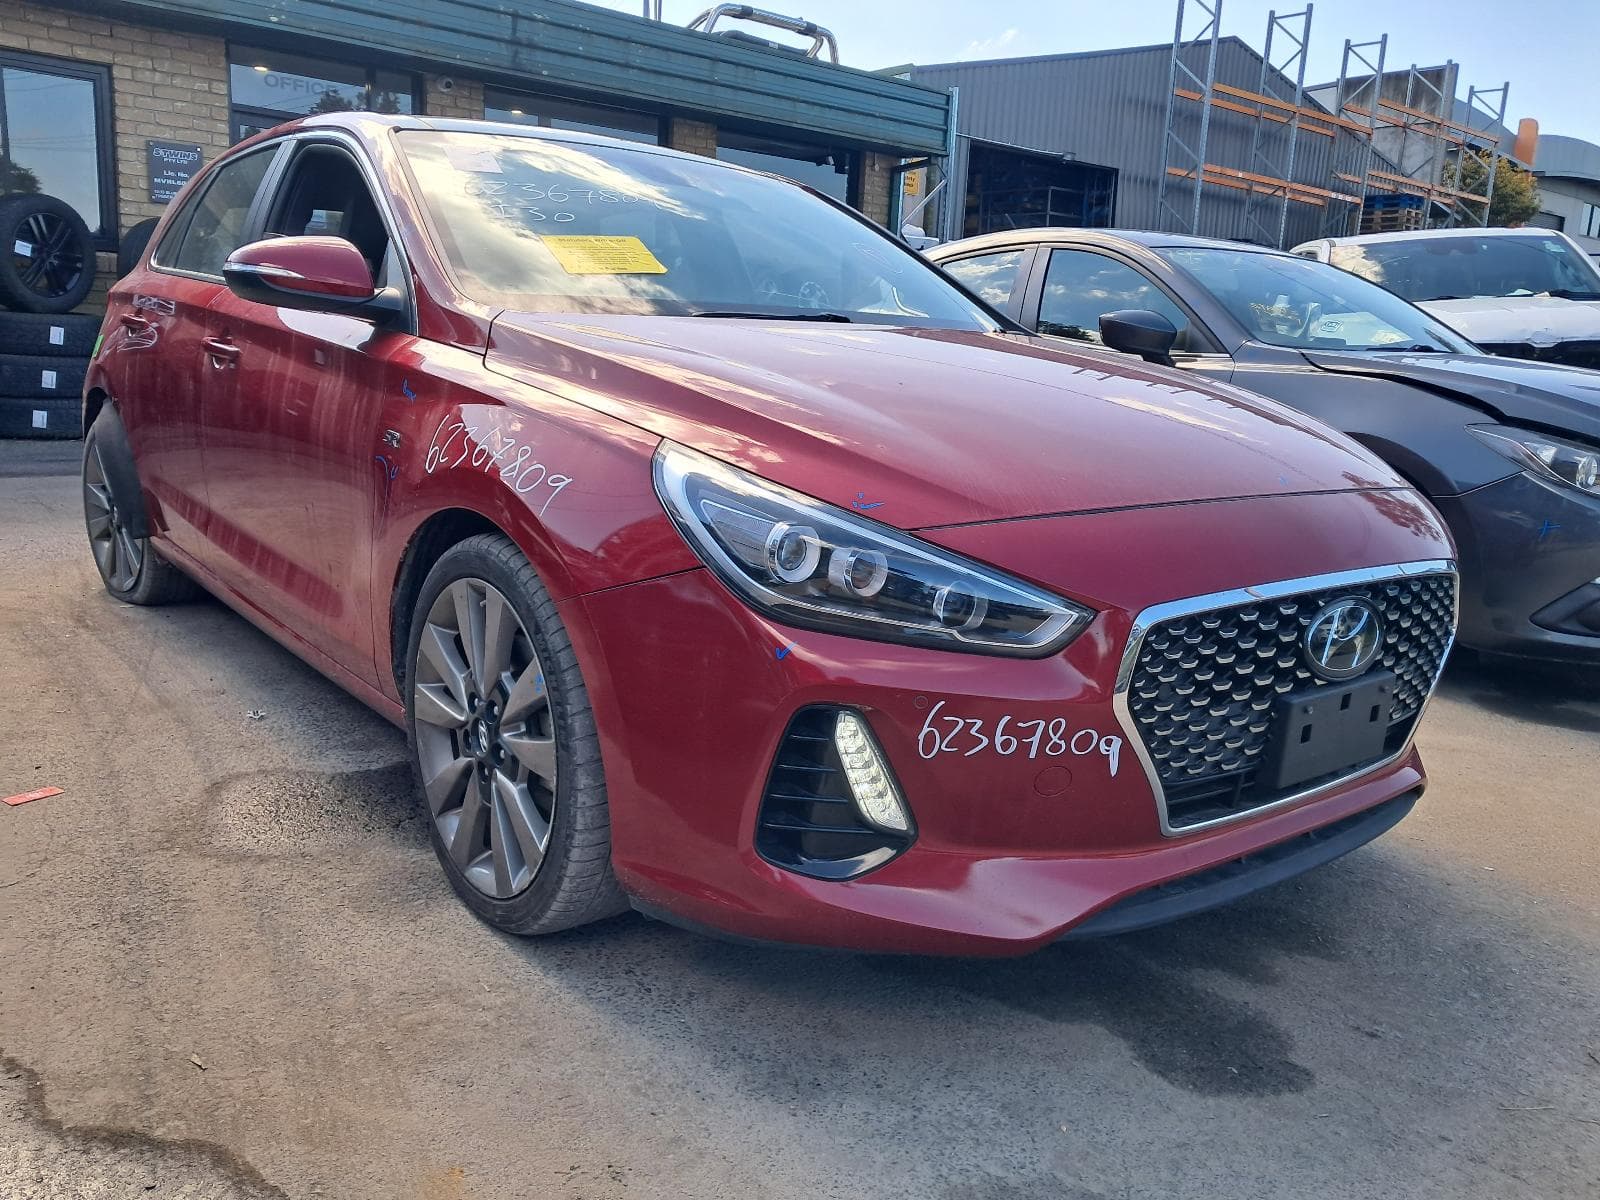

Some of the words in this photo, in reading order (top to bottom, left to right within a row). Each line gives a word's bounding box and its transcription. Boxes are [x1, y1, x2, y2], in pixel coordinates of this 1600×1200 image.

[464, 181, 664, 210] 6236780
[425, 414, 573, 517] 62367809
[918, 701, 1122, 777] 62367809
